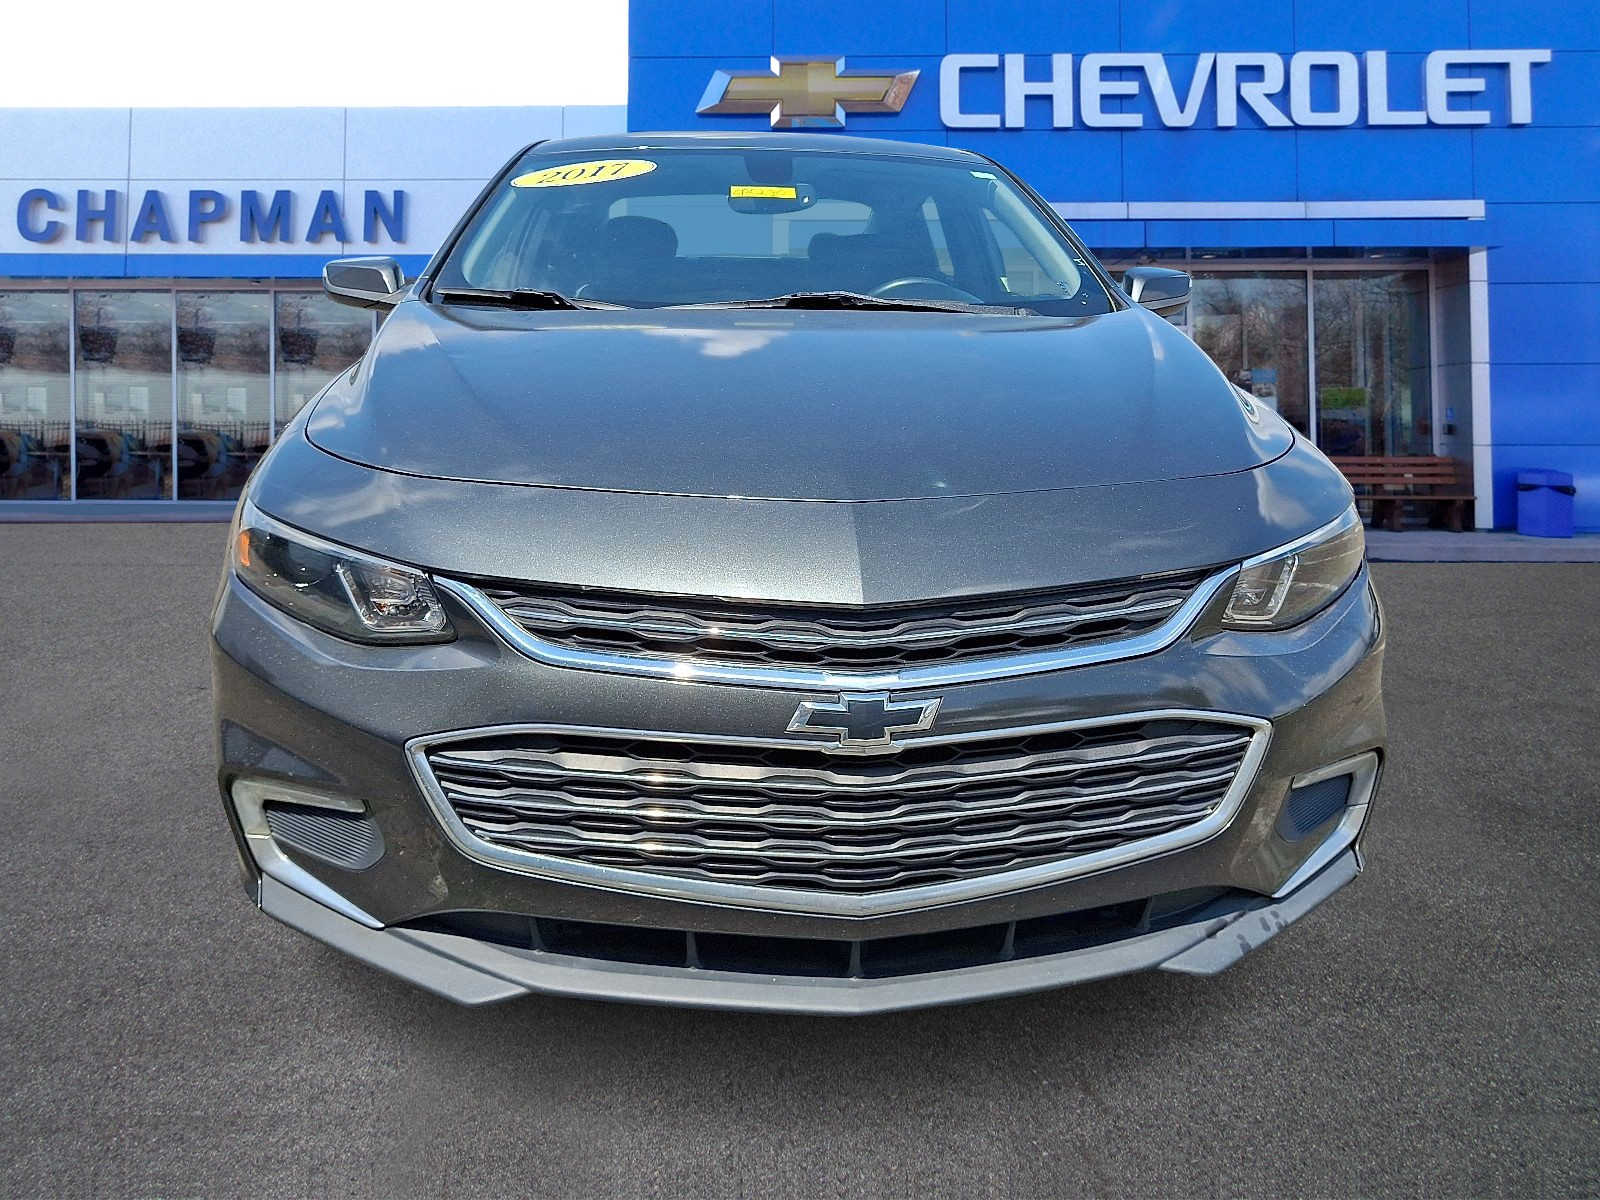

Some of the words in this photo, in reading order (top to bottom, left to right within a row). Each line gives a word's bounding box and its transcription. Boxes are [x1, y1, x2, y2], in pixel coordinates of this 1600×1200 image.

[939, 49, 1552, 129] CHEVROLET
[536, 162, 630, 184] 2017
[17, 188, 409, 244] CHAPMAN
